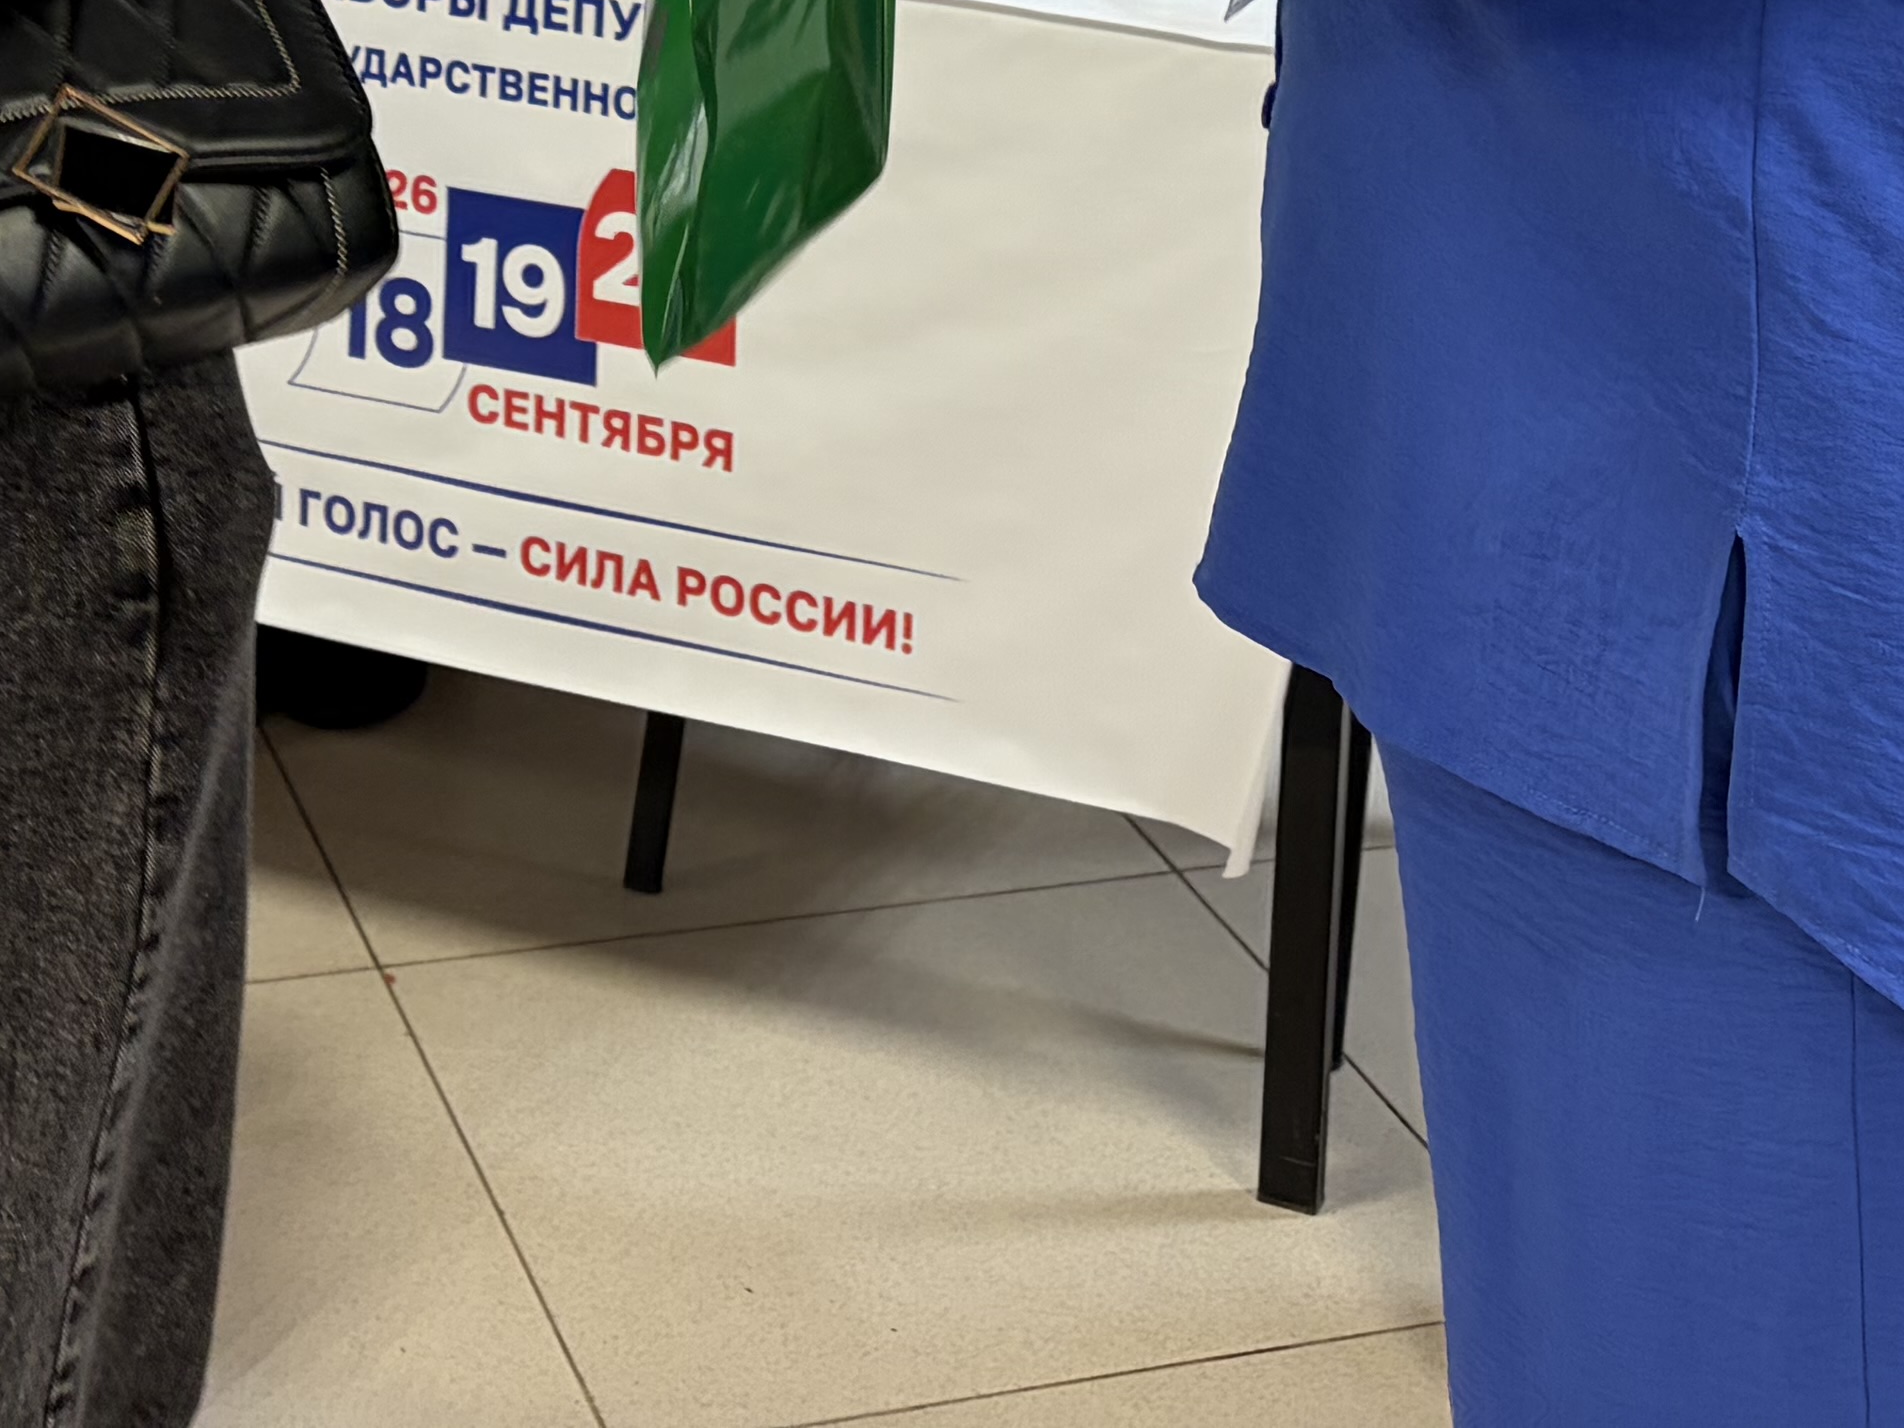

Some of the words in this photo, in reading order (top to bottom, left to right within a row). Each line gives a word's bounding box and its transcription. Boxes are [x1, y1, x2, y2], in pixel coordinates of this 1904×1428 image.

[386, 169, 439, 215] 26
[460, 236, 566, 339] 19
[593, 210, 641, 309] 2
[467, 383, 735, 474] СЕНТЯБРЯ
[298, 487, 459, 558] ГОЛОС
[519, 534, 661, 602] СИЛА
[675, 565, 914, 656] РОССИИ!
